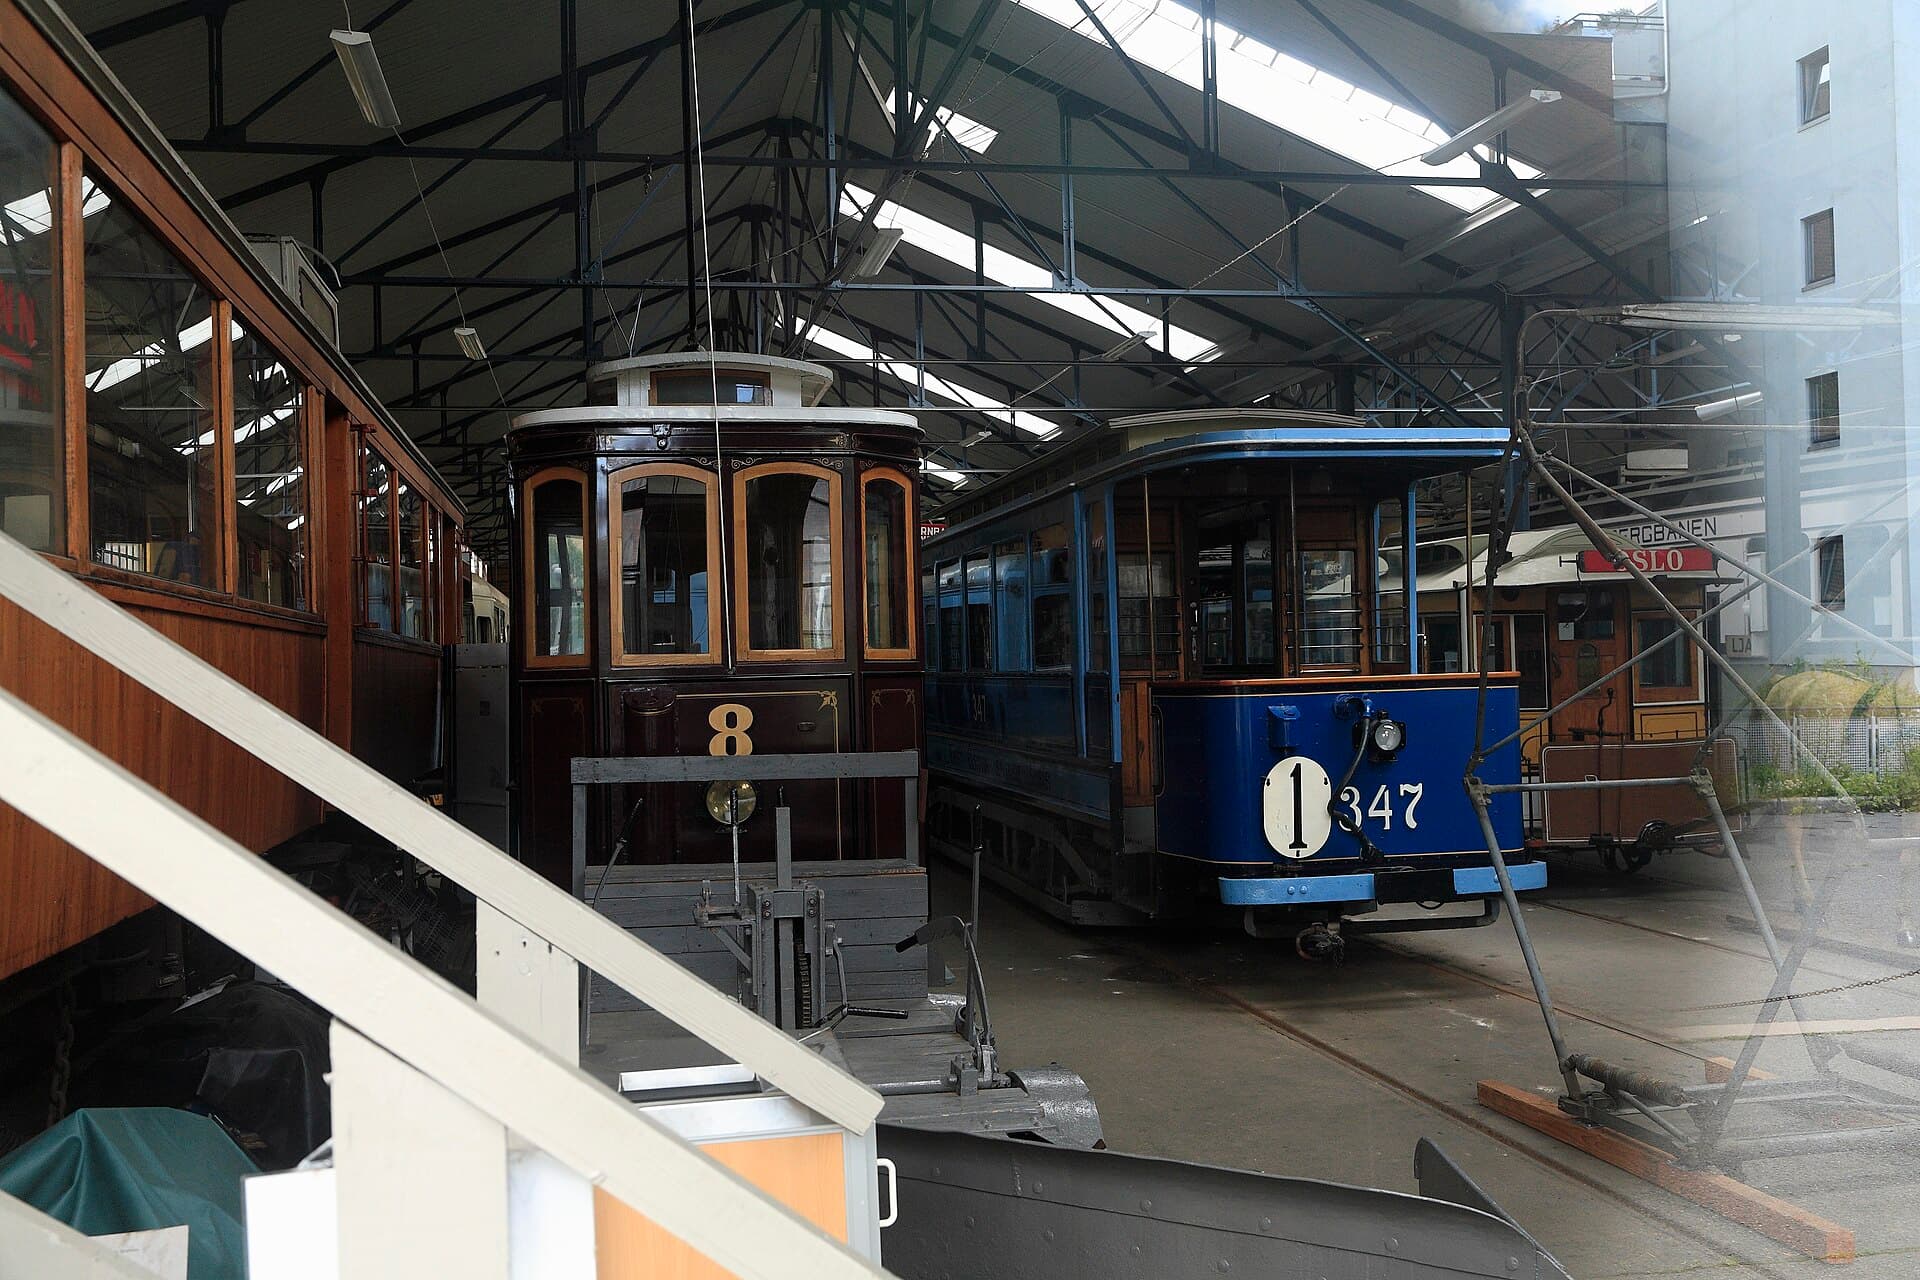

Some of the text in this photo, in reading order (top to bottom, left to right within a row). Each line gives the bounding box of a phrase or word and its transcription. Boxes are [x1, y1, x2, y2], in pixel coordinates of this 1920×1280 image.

[1613, 517, 1717, 544] ERGBANEN
[1615, 549, 1684, 572] SLO
[972, 692, 987, 722] 347
[708, 703, 753, 756] 8
[1288, 762, 1308, 850] 1
[1338, 783, 1423, 832] 347
